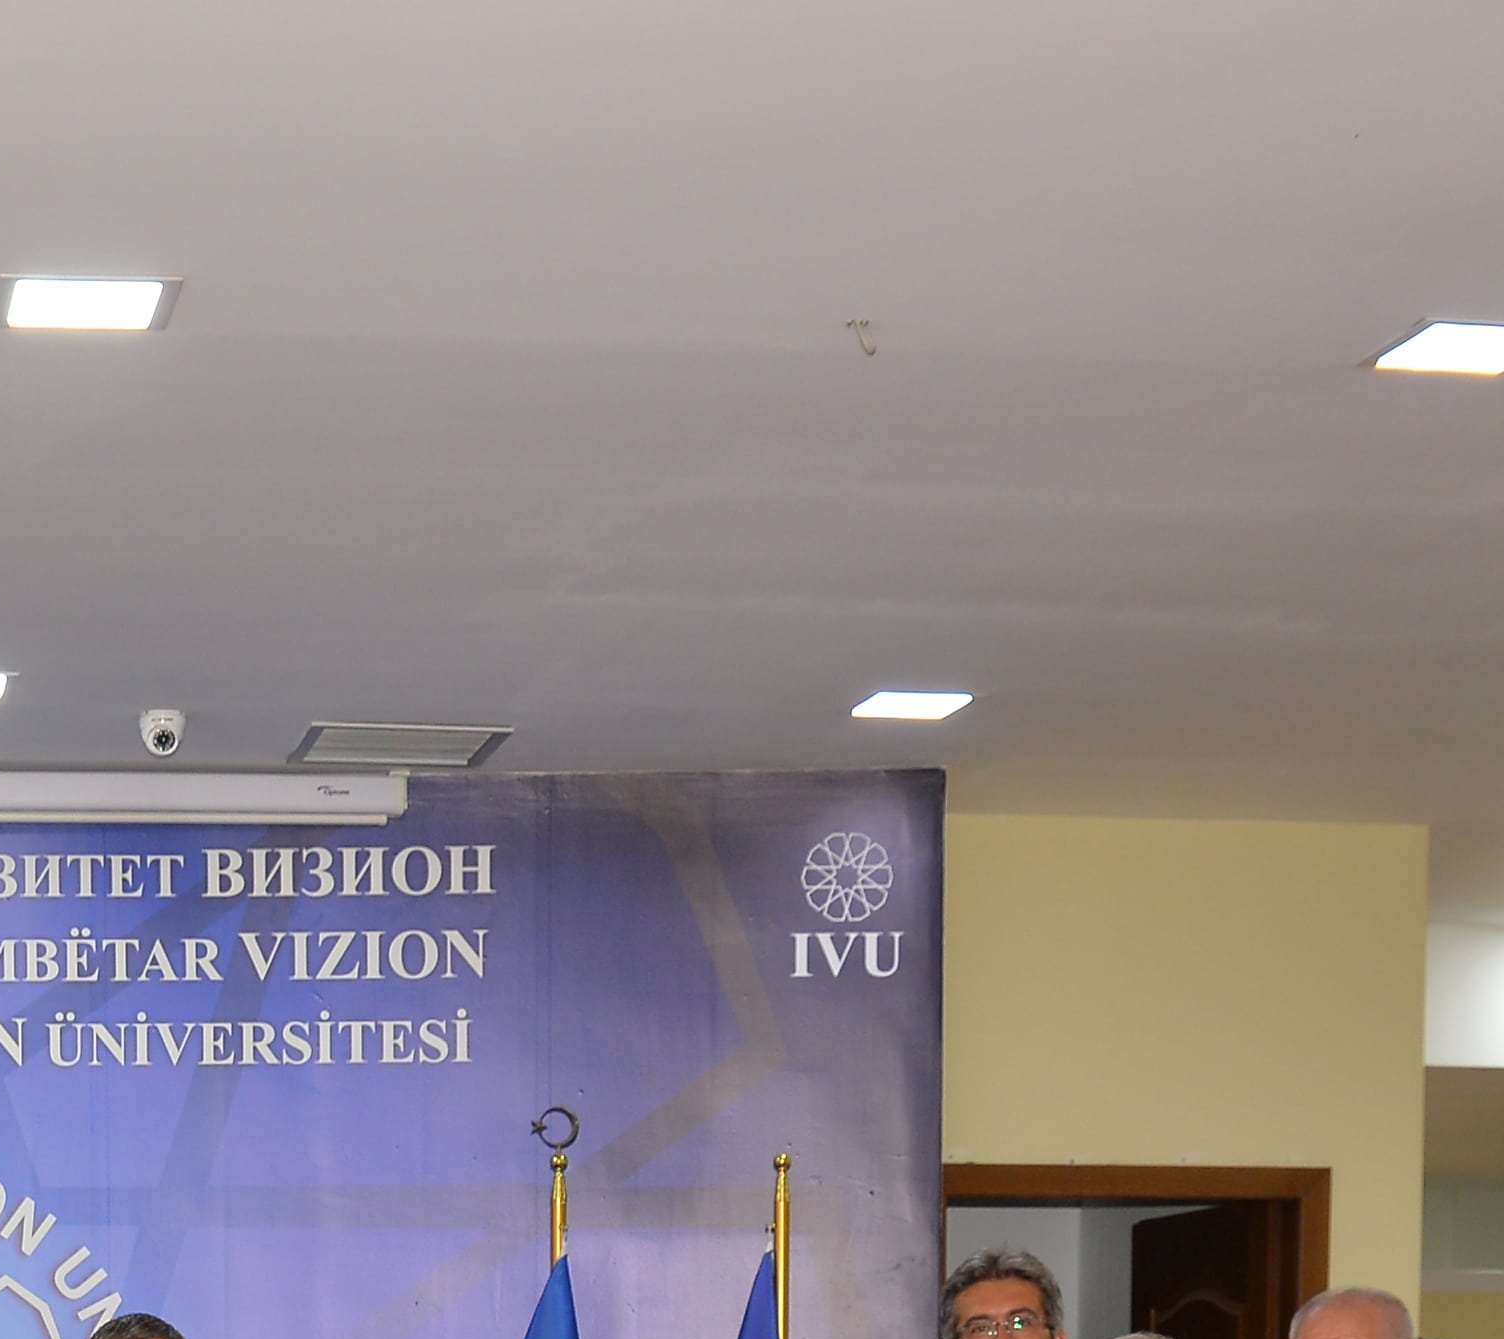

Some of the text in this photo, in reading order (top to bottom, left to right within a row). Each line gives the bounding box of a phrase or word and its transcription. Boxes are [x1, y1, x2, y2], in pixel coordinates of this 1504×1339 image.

[201, 845, 497, 898] ВИЗИОН
[238, 929, 489, 980] VIZION
[790, 931, 904, 978] IVU
[45, 1008, 473, 1067] ÜNİVERSİTESİ
